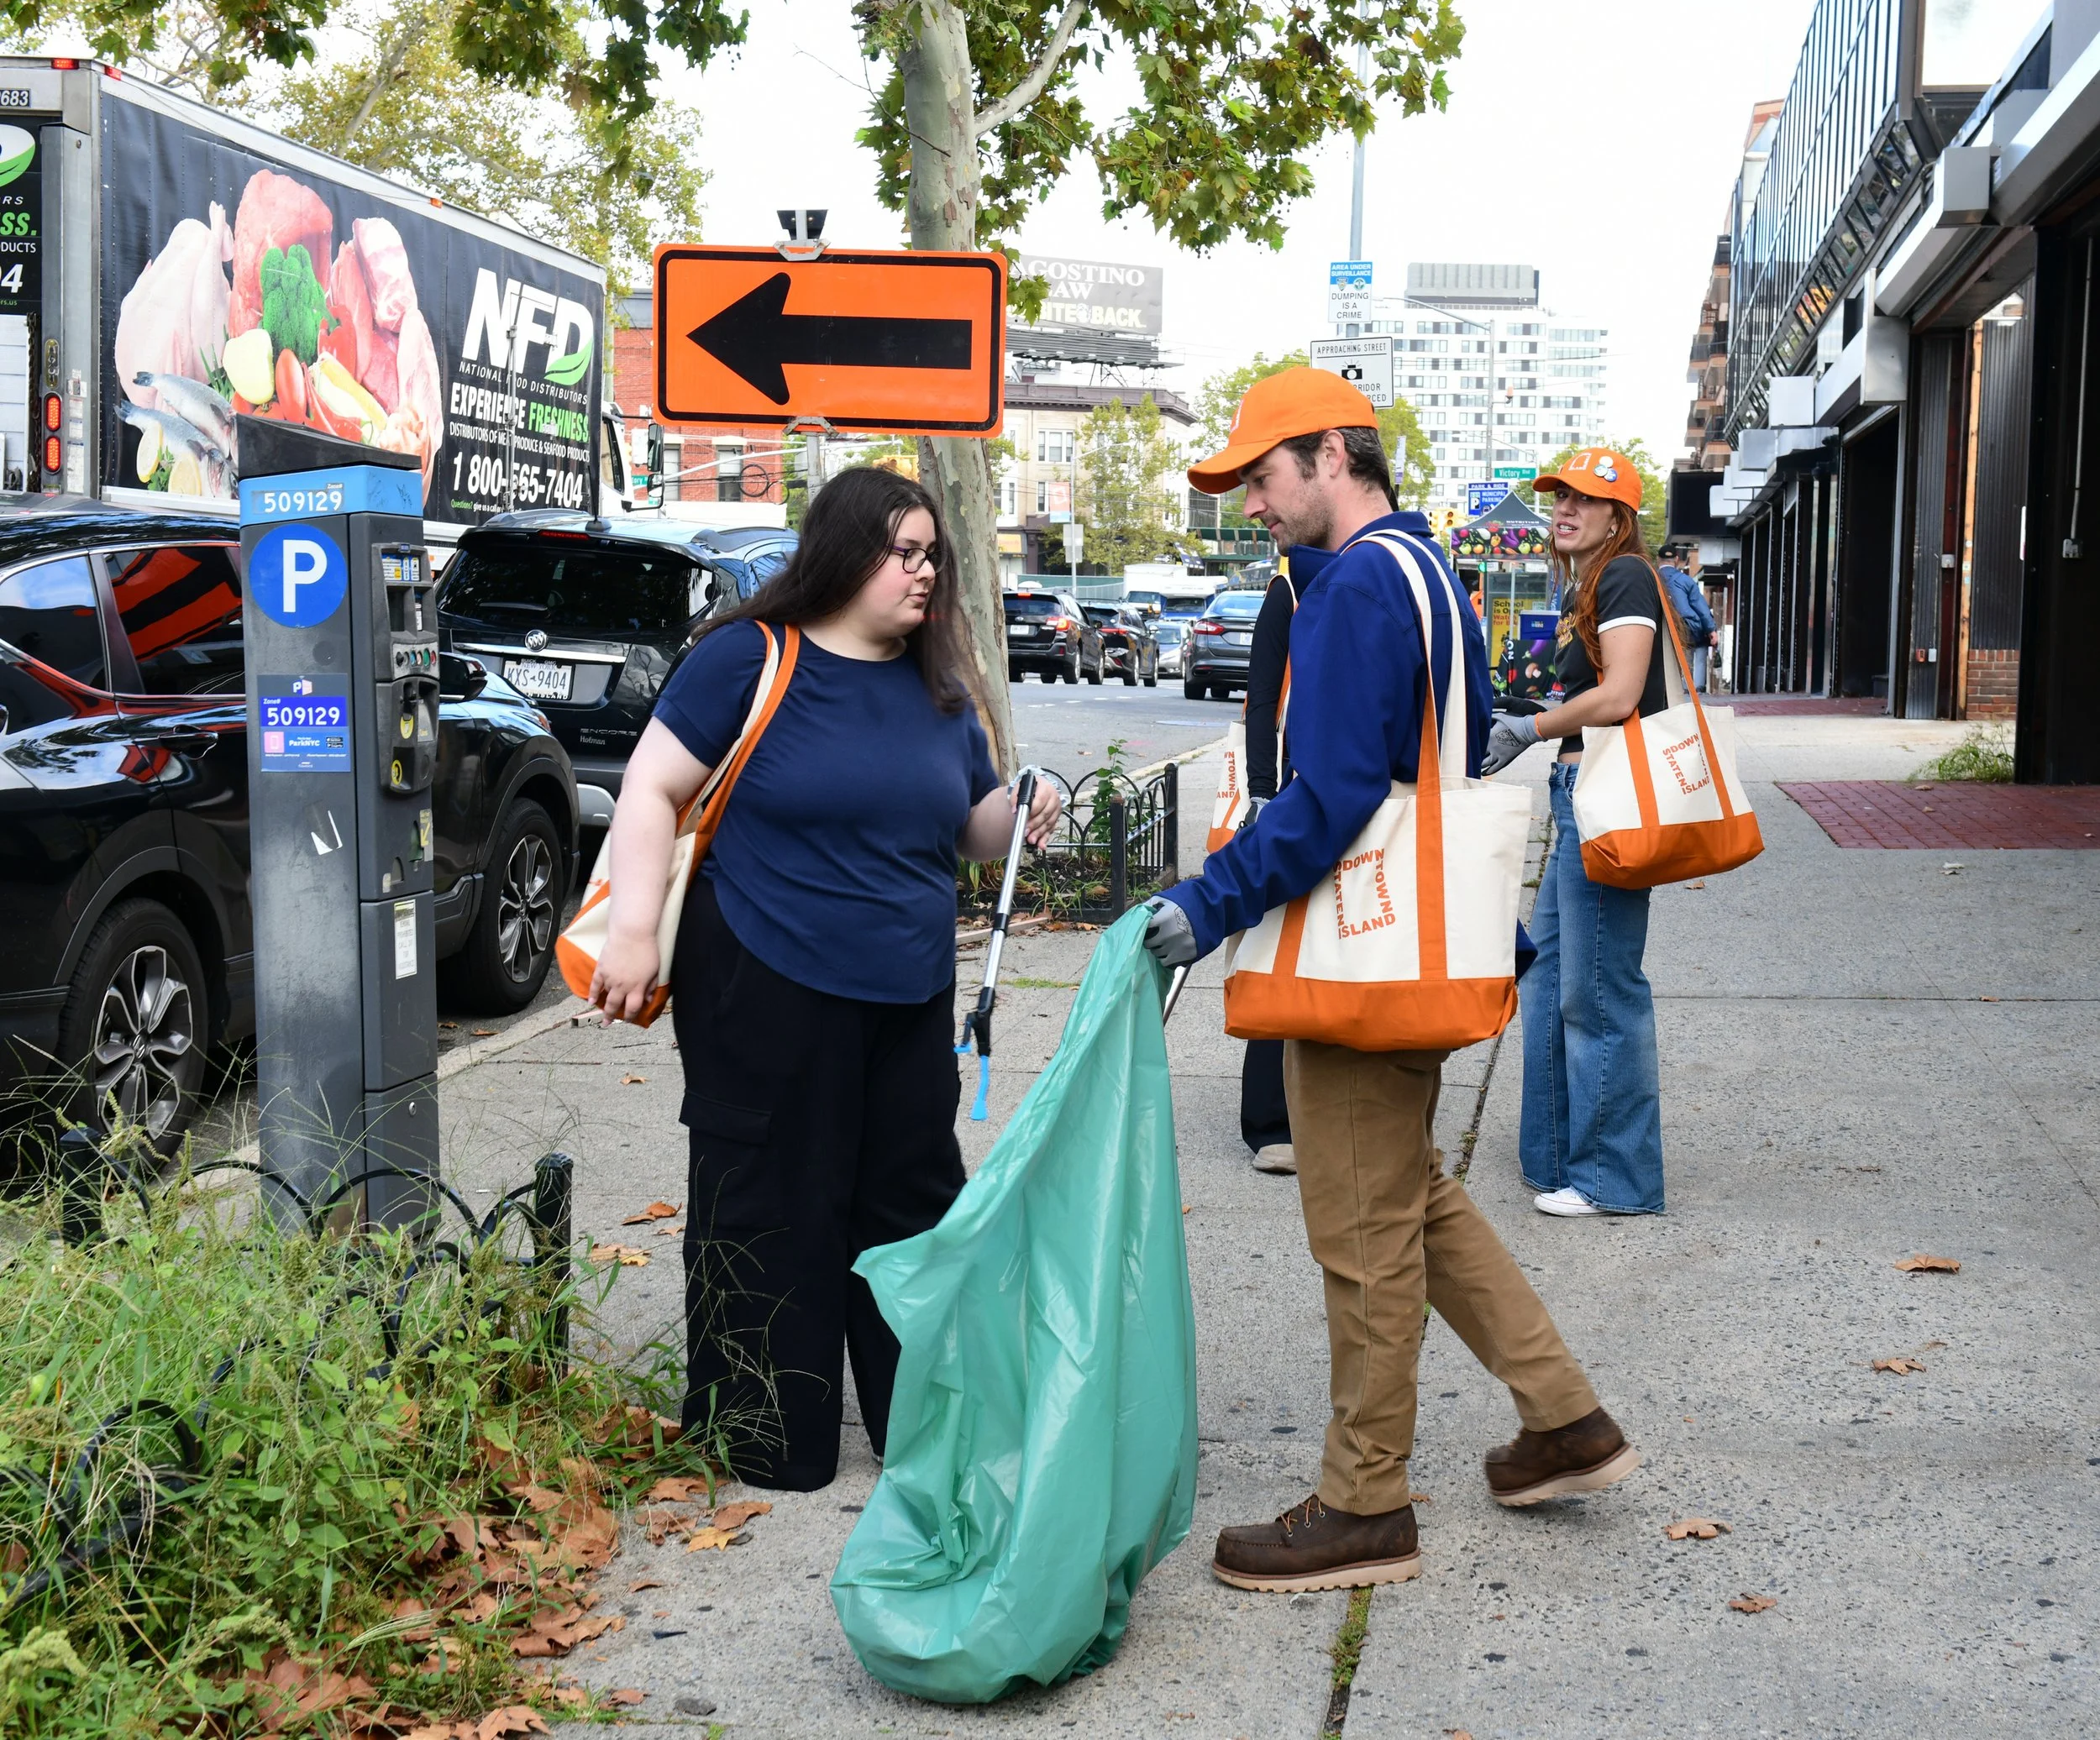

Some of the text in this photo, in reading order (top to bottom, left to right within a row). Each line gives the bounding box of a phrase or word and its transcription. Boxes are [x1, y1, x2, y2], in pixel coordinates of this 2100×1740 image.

[0, 90, 29, 107] 683
[0, 196, 24, 205] RS
[0, 212, 37, 236] SS.
[0, 263, 24, 293] 4
[461, 267, 594, 377] NFD
[1316, 343, 1387, 354] APPROACHING STREET
[459, 361, 502, 383] NATIONAL
[530, 380, 588, 405] DISTRIBUTORS
[449, 421, 489, 443] DISTRIBUTORS
[489, 429, 498, 443] OF
[538, 440, 543, 453] &
[543, 442, 566, 459] SEAFOOD
[567, 447, 591, 463] PRODUCTS
[453, 451, 463, 491] 1
[1499, 469, 1520, 478] Victory
[264, 490, 343, 513] 509129
[282, 539, 328, 613] P
[538, 670, 567, 689] 9404
[267, 706, 340, 726] 509129
[580, 728, 638, 736] ENCORE
[1669, 732, 1699, 753] DOWN
[1662, 747, 1688, 787] STATEN
[1681, 775, 1710, 795] ISLAND
[1342, 847, 1385, 872] DOWN
[1333, 859, 1345, 927] STATEN
[1375, 859, 1394, 914] TOWN
[1338, 912, 1396, 940] ISLAND
